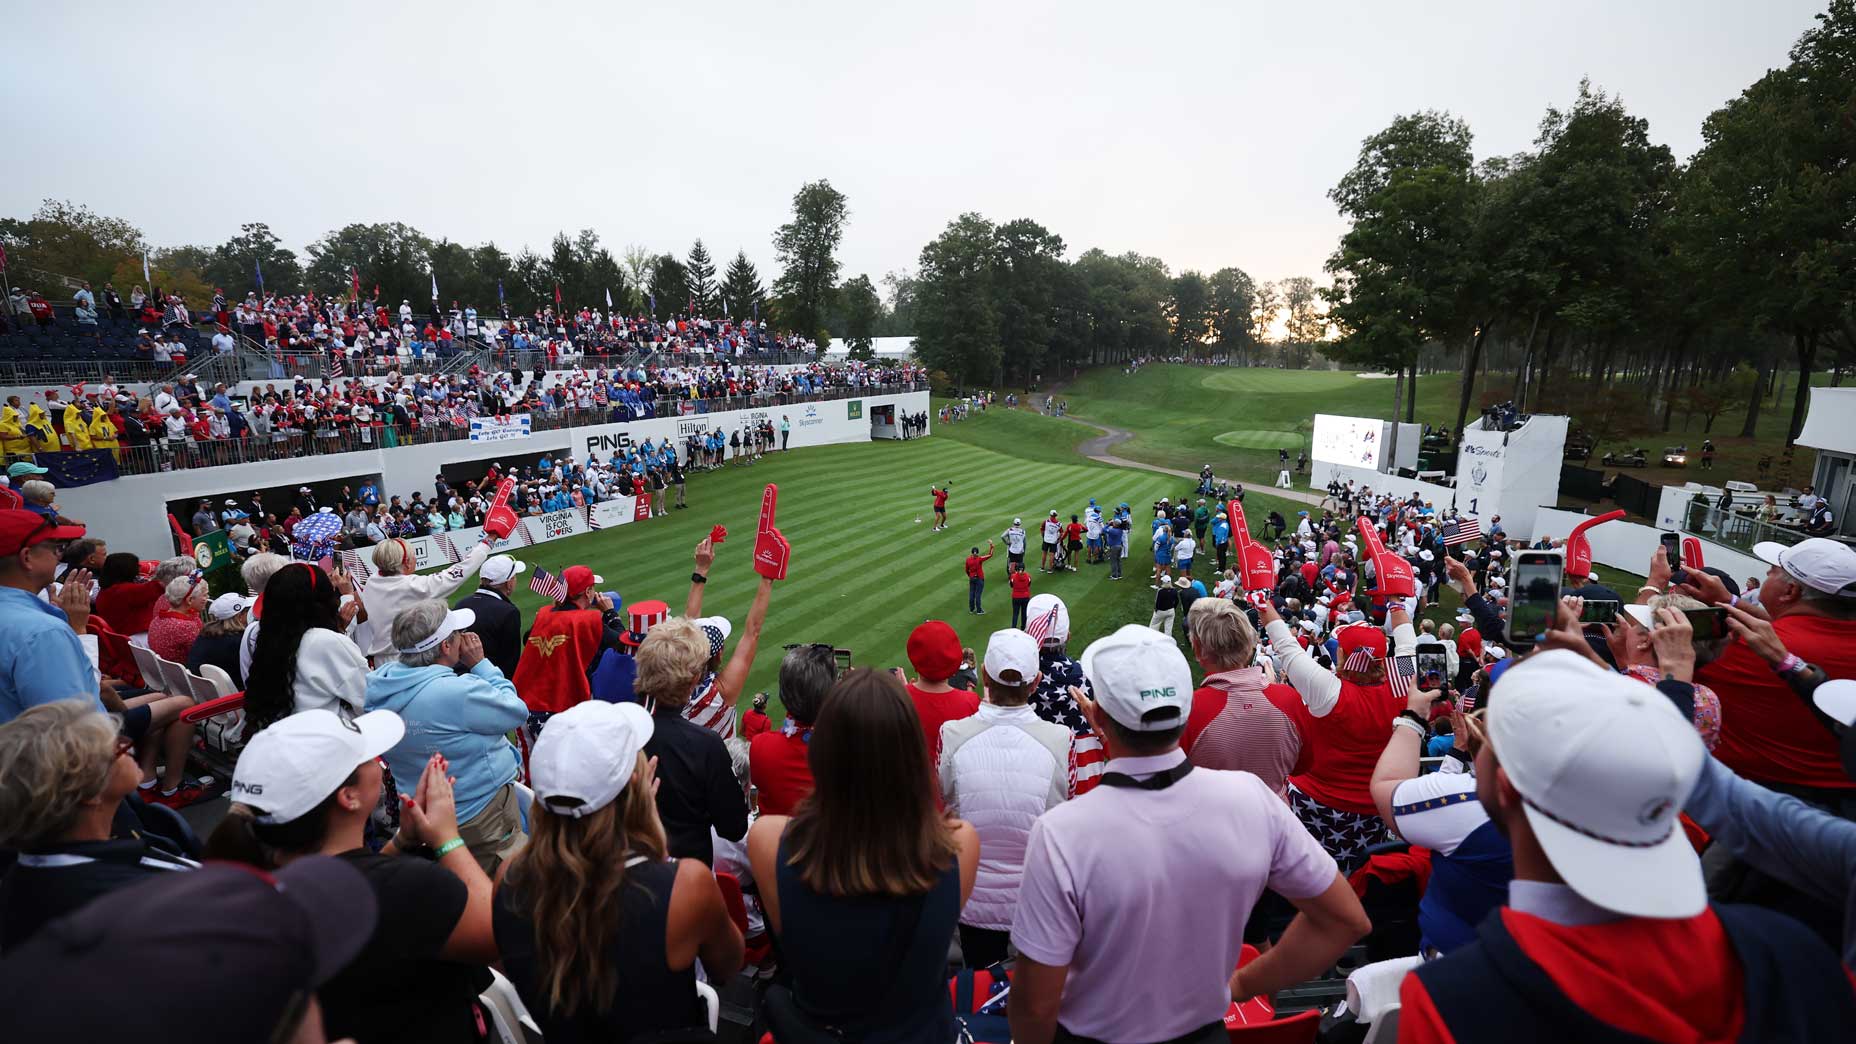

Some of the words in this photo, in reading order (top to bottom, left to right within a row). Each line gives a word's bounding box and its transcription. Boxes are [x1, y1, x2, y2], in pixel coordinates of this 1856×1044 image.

[680, 423, 707, 434] Hilton
[587, 432, 630, 453] PING
[1468, 498, 1479, 515] 1
[540, 511, 573, 524] VIRGINIA
[546, 521, 552, 531] IS
[553, 519, 568, 529] FOR
[1140, 686, 1177, 701] PING
[233, 779, 263, 795] PING
